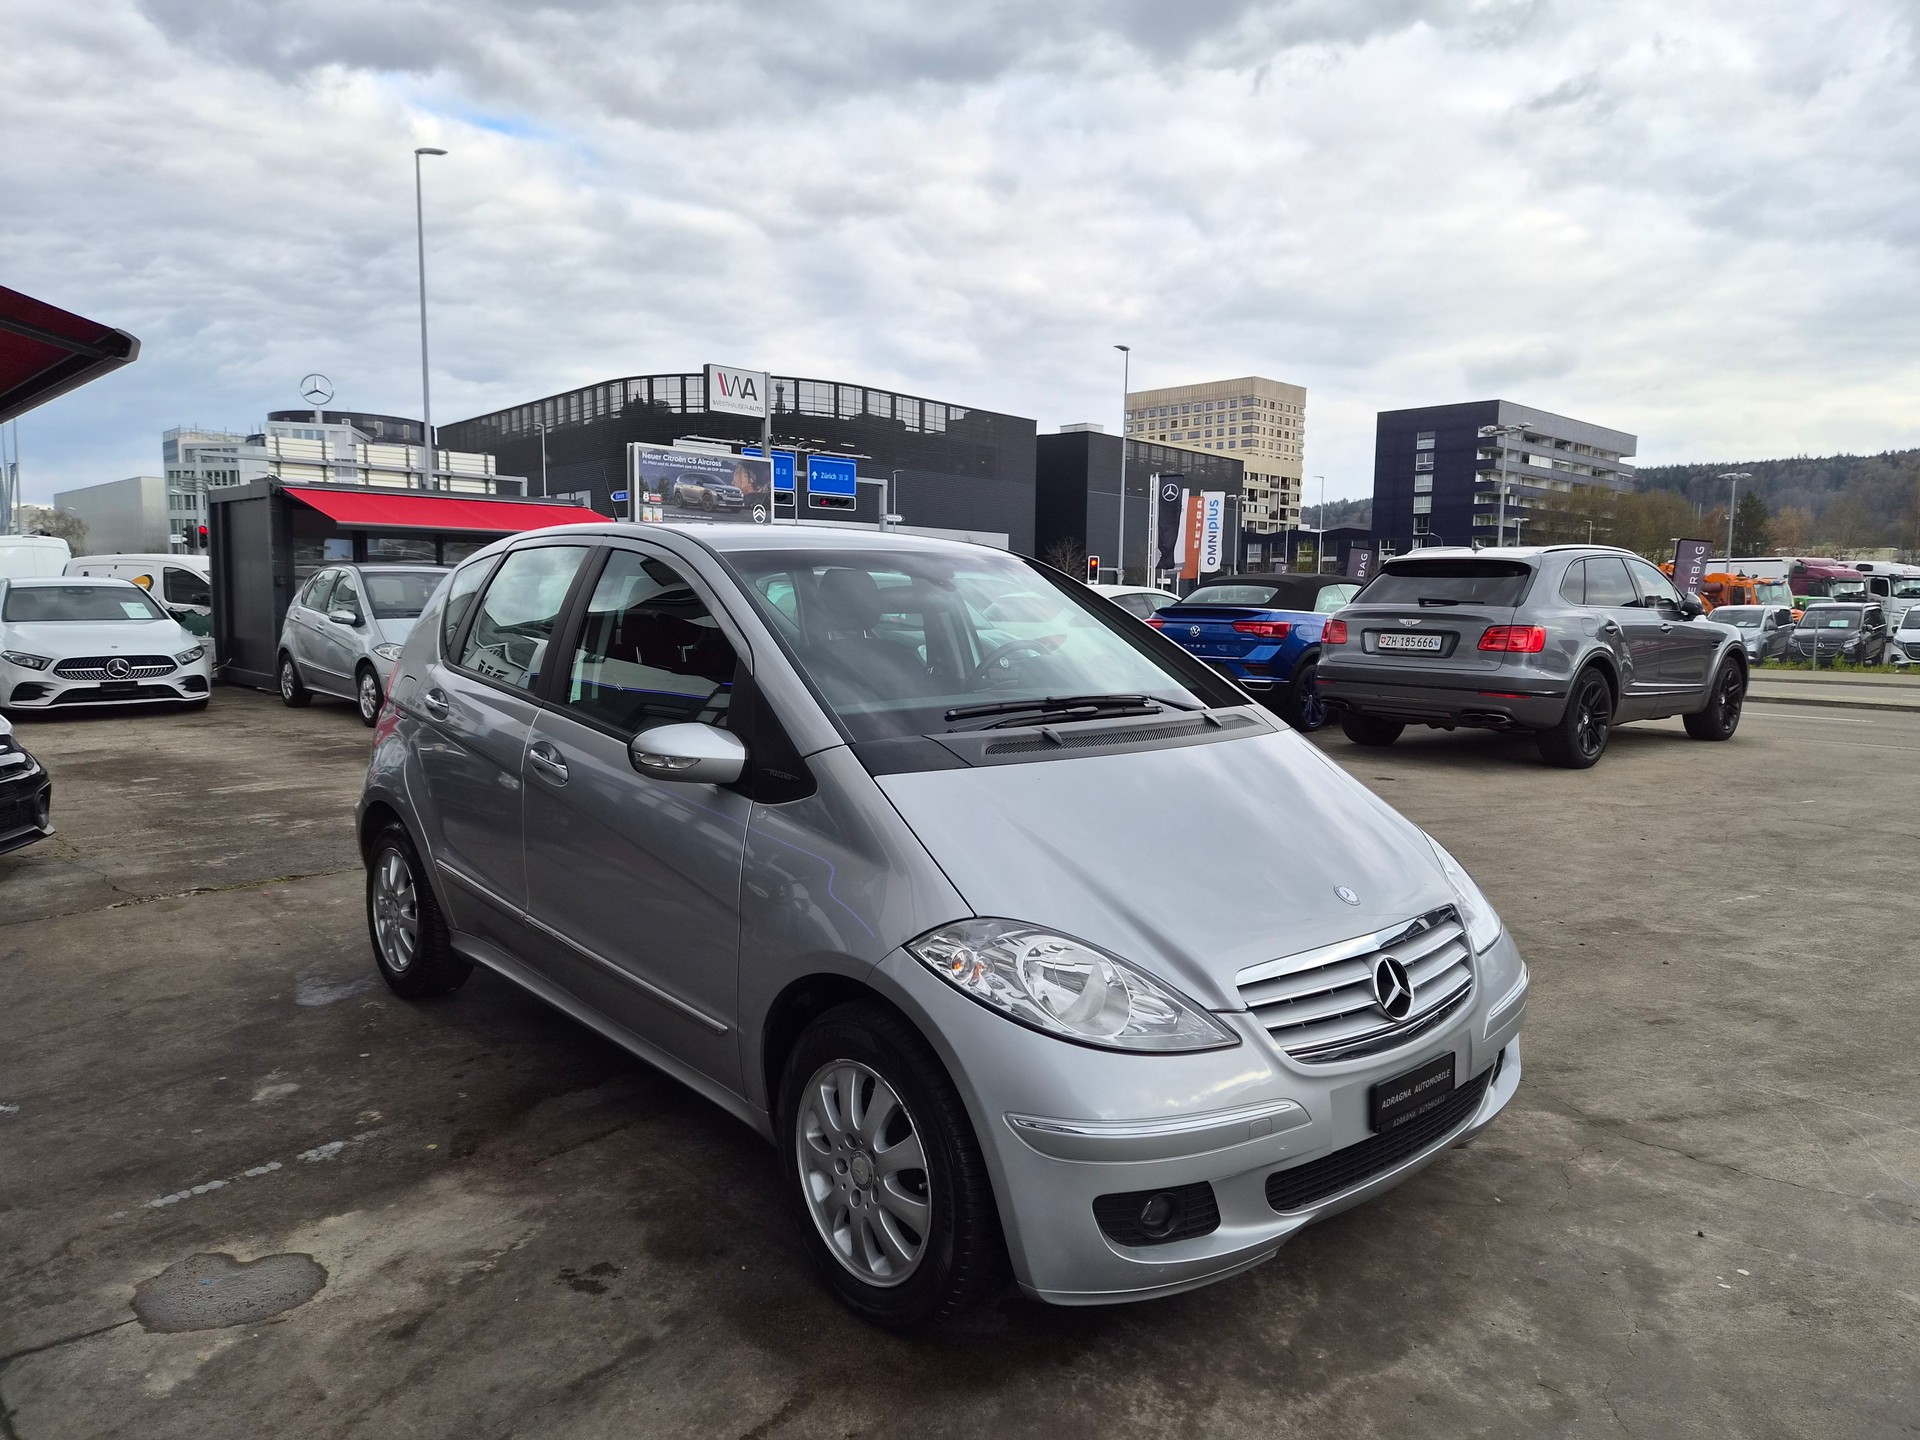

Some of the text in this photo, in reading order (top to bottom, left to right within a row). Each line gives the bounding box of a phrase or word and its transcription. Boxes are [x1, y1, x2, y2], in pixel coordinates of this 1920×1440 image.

[641, 451, 722, 467] Neuer Citroën C5 Aircross
[821, 472, 837, 480] Zürich
[1193, 500, 1203, 549] SETRA
[1382, 1069, 1450, 1109] ADRAGNA AUTOMOBILE
